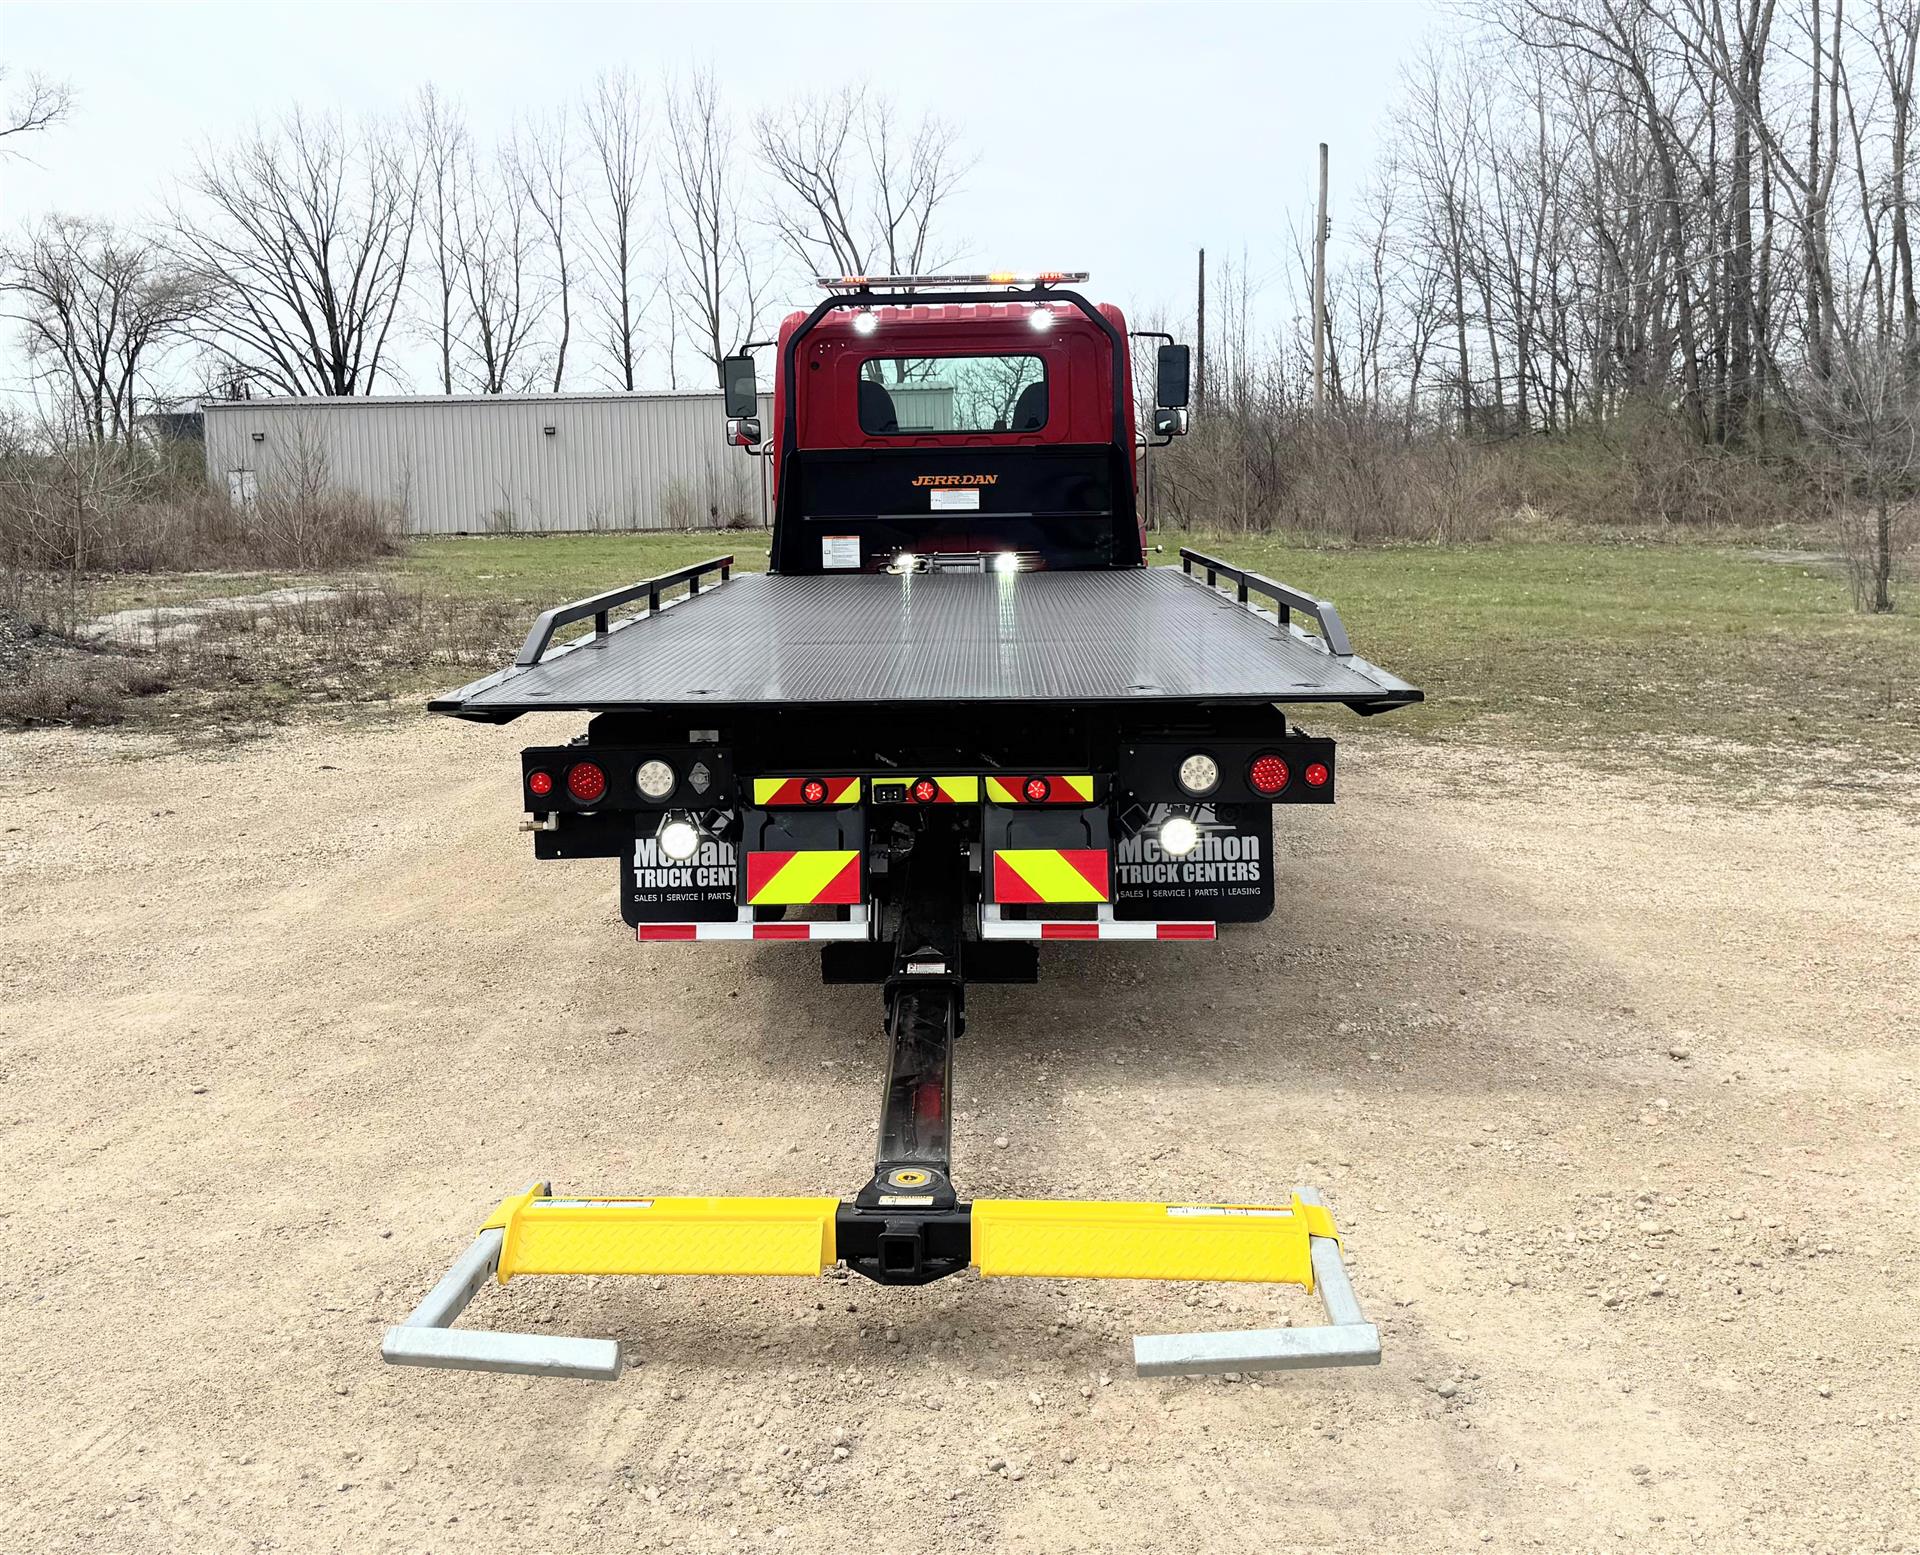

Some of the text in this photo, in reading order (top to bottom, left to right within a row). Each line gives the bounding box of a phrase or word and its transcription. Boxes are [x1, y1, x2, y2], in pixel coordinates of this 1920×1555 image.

[633, 867, 737, 888] TRUCK CENT
[1119, 861, 1260, 884] TRUCK CENTERS
[634, 892, 732, 902] SALES SERVICE PARTS
[1120, 887, 1261, 898] SALES SERVICE PARTS LEASING
